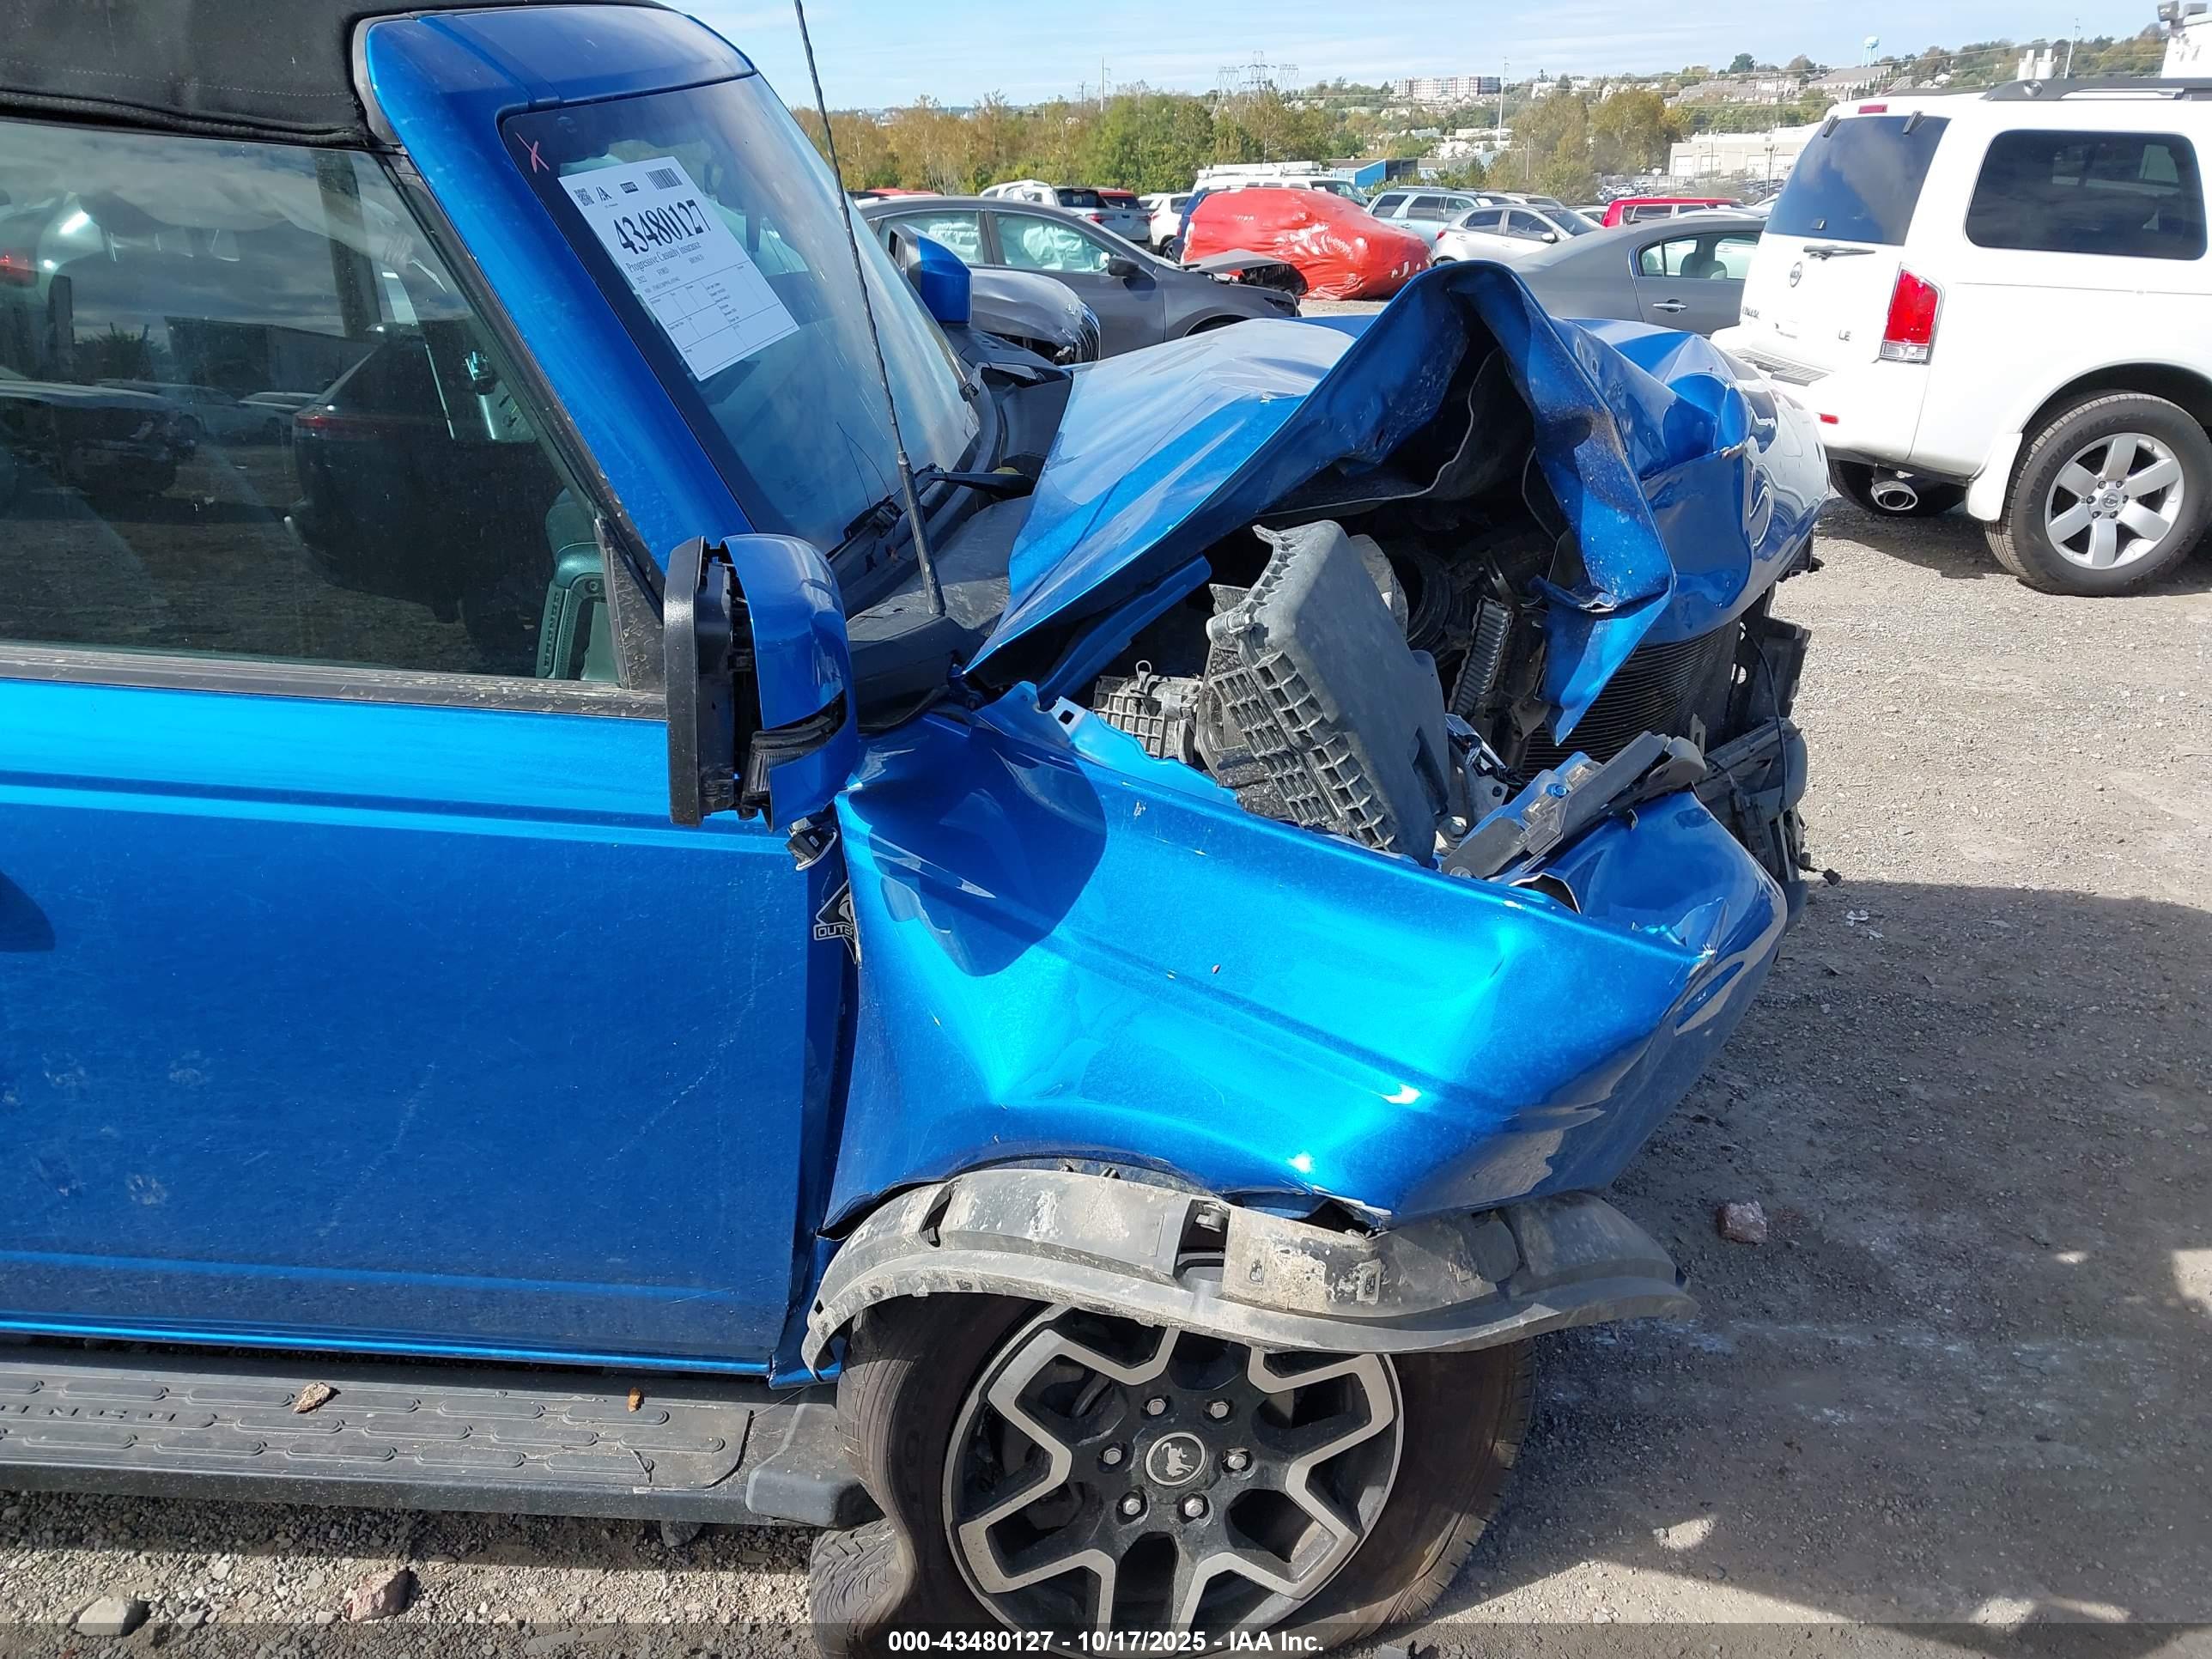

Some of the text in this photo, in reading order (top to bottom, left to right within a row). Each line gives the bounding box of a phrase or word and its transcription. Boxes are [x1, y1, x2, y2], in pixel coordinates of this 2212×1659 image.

[612, 198, 712, 255] 43480127
[625, 241, 702, 272] Progressive Casualty Insurance
[1838, 329, 1852, 342] LE
